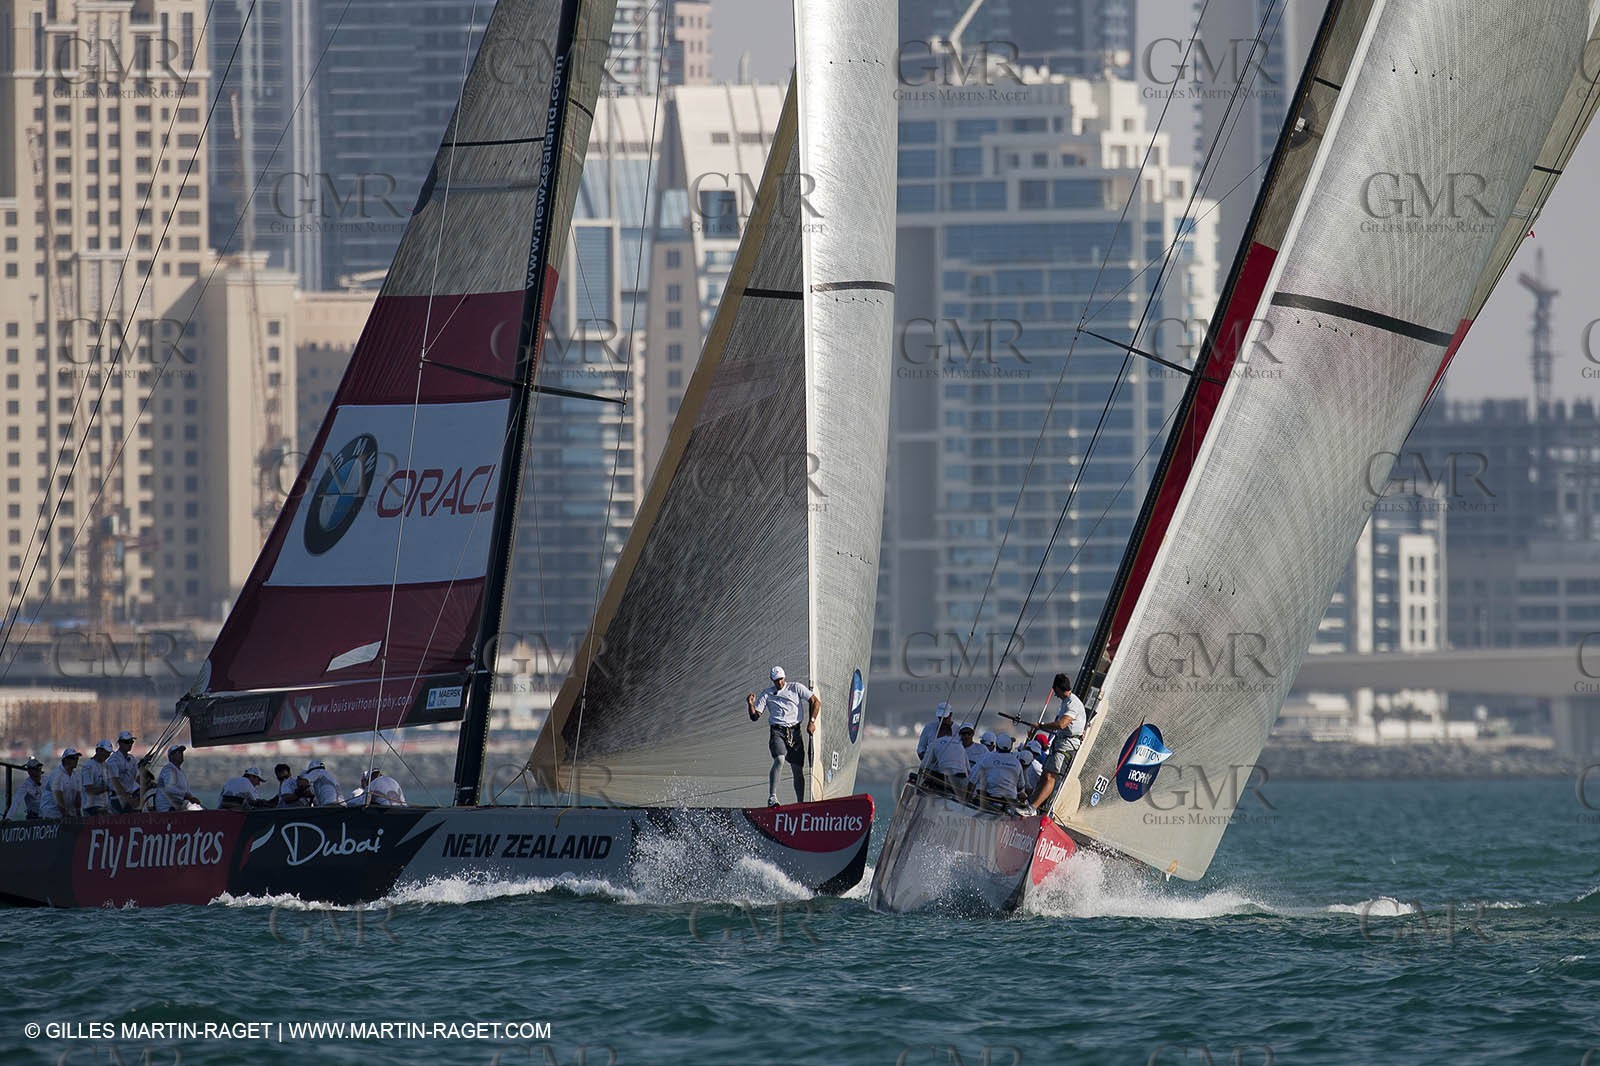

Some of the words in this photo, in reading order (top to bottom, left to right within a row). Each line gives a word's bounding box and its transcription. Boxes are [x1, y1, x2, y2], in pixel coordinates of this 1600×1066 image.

[527, 55, 564, 289] www.newzealand.com
[333, 437, 377, 475] BMW
[439, 688, 461, 698] MAERSK
[1135, 747, 1162, 761] VUITTON
[1128, 769, 1152, 784] TROPHY
[33, 824, 60, 840] TROPHY
[775, 813, 798, 836] Fly
[800, 812, 863, 832] Emirates
[87, 828, 124, 878] Fly
[125, 823, 224, 868] Emirates
[281, 822, 384, 866] Dubai
[442, 833, 501, 858] NEW
[501, 834, 613, 860] ZEALAND
